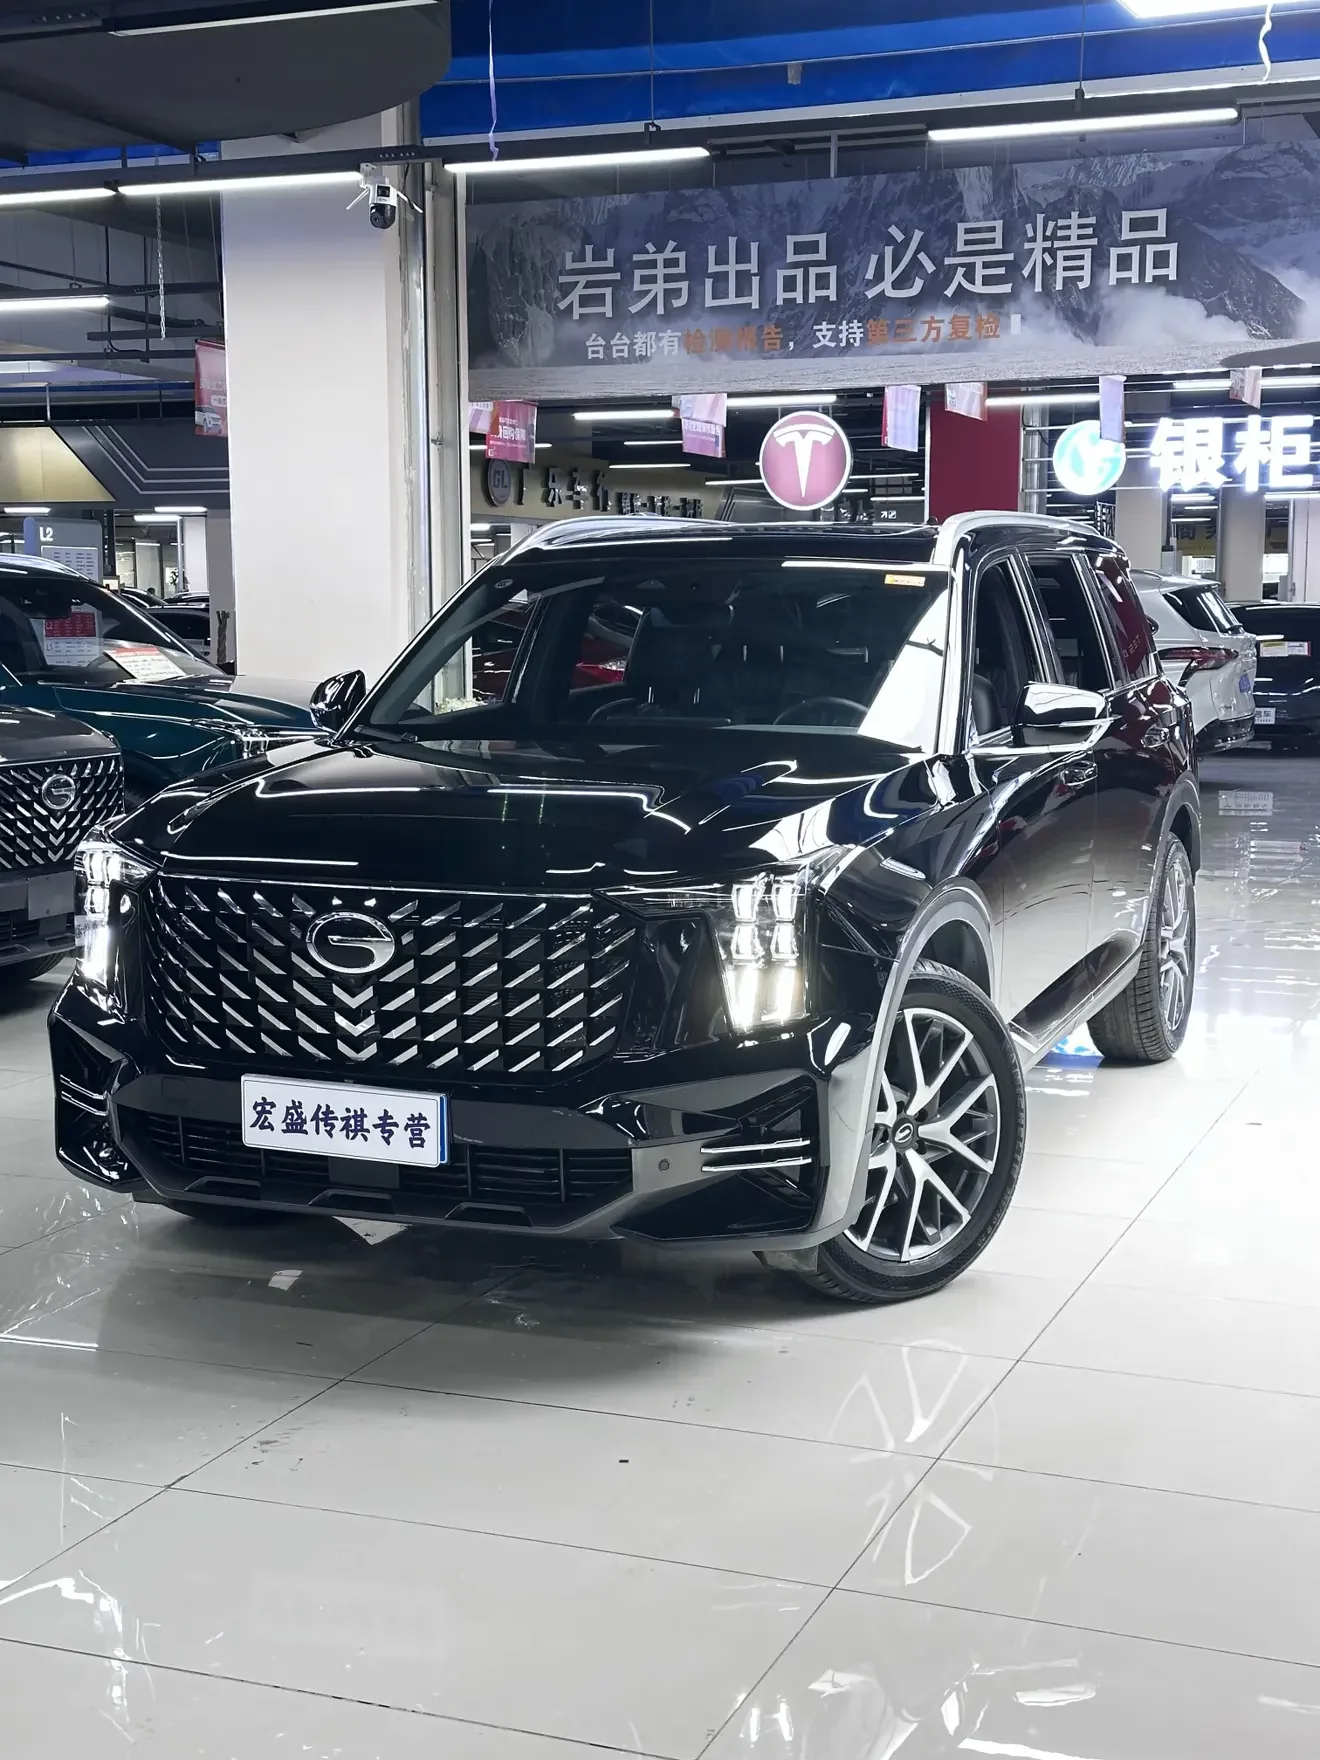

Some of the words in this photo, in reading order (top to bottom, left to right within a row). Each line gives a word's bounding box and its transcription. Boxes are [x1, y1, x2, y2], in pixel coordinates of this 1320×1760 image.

[557, 232, 838, 320] 岩弟出品
[863, 207, 1179, 300] 必是精品
[1149, 414, 1314, 493] 银柜
[39, 526, 54, 542] L2
[249, 1096, 431, 1149] 宏盛传祺专营
